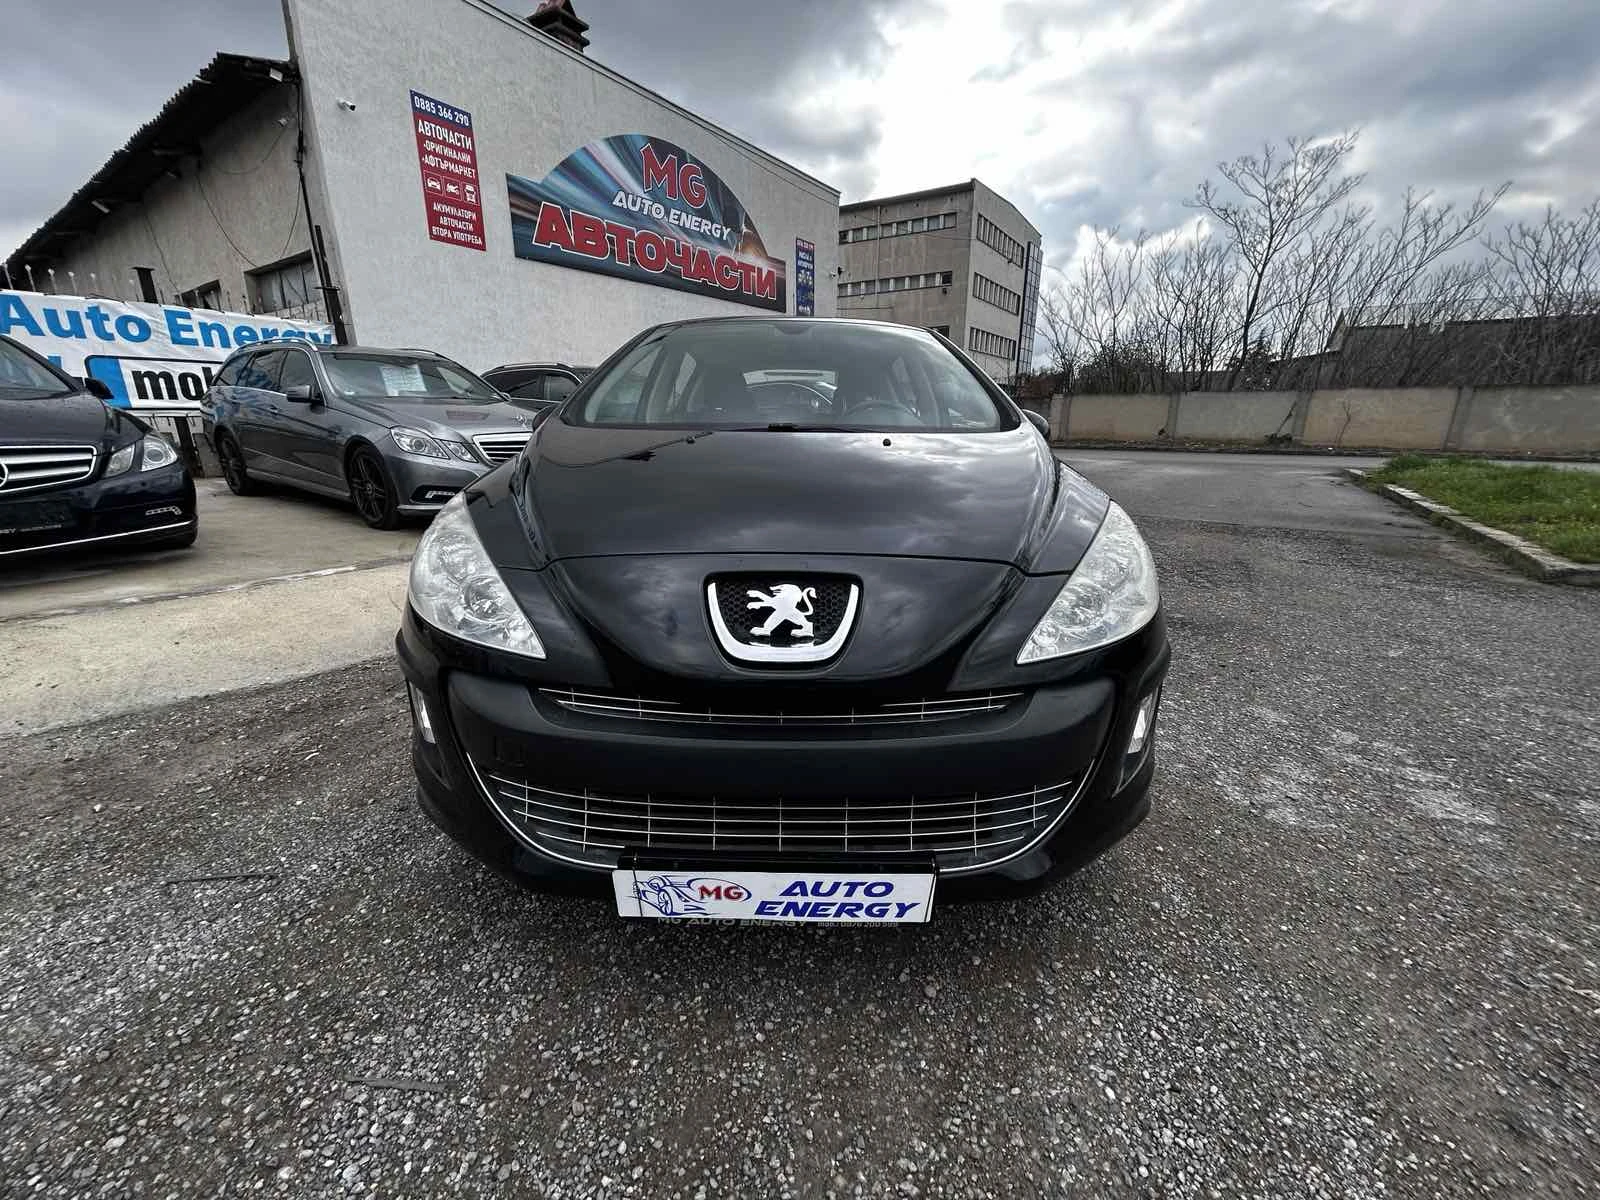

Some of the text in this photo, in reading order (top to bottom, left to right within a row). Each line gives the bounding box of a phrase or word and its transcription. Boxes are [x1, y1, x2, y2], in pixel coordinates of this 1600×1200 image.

[414, 95, 469, 126] 0885 366 290
[418, 119, 472, 151] АВТОЧАСТИ
[640, 143, 708, 209] MG
[668, 209, 731, 240] ENERGY
[533, 201, 776, 299] АВТОЧАСТИ
[0, 294, 151, 343] Auto
[698, 885, 744, 900] MG
[779, 880, 895, 898] AUTO
[754, 900, 921, 918] ENERGY
